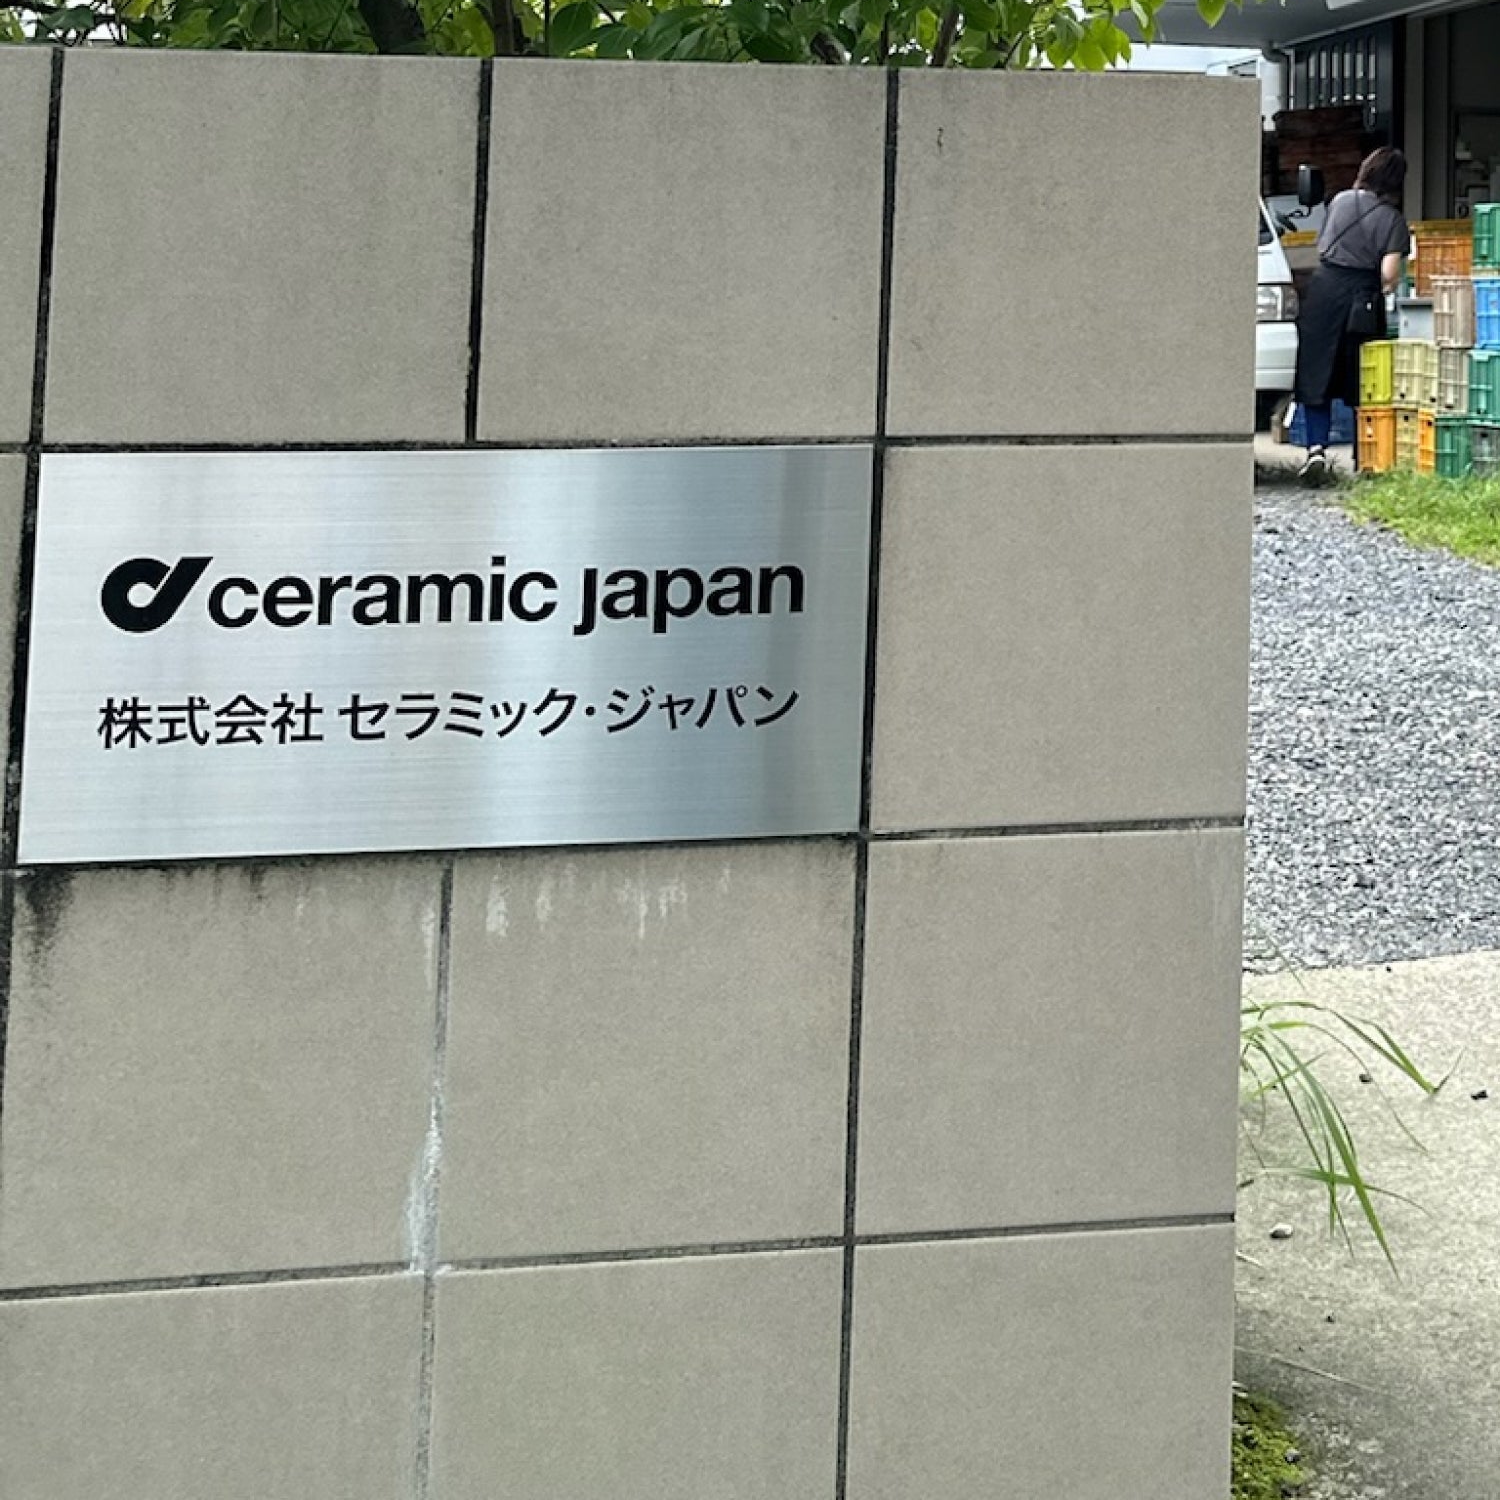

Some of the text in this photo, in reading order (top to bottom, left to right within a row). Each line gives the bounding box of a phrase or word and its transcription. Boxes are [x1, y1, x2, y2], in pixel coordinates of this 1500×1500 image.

[208, 556, 558, 629] ceramic
[97, 692, 324, 750] 株式会社
